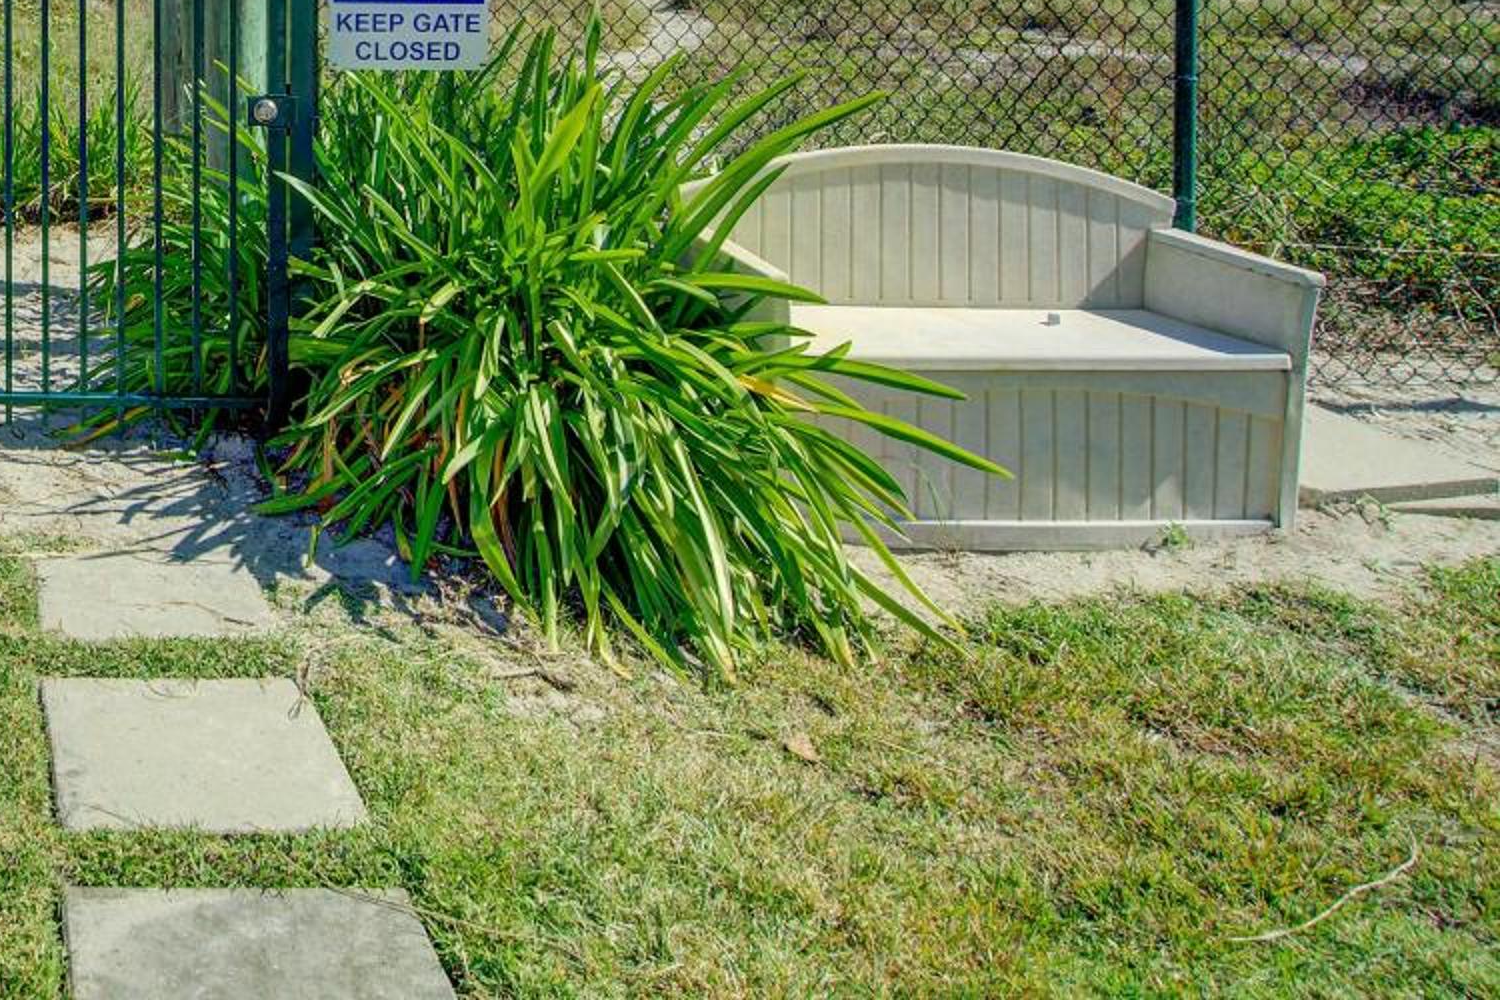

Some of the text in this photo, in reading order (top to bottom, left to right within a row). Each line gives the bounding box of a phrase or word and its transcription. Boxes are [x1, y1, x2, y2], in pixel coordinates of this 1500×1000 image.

[336, 13, 481, 33] KEEP GATE
[355, 41, 461, 61] CLOSED
